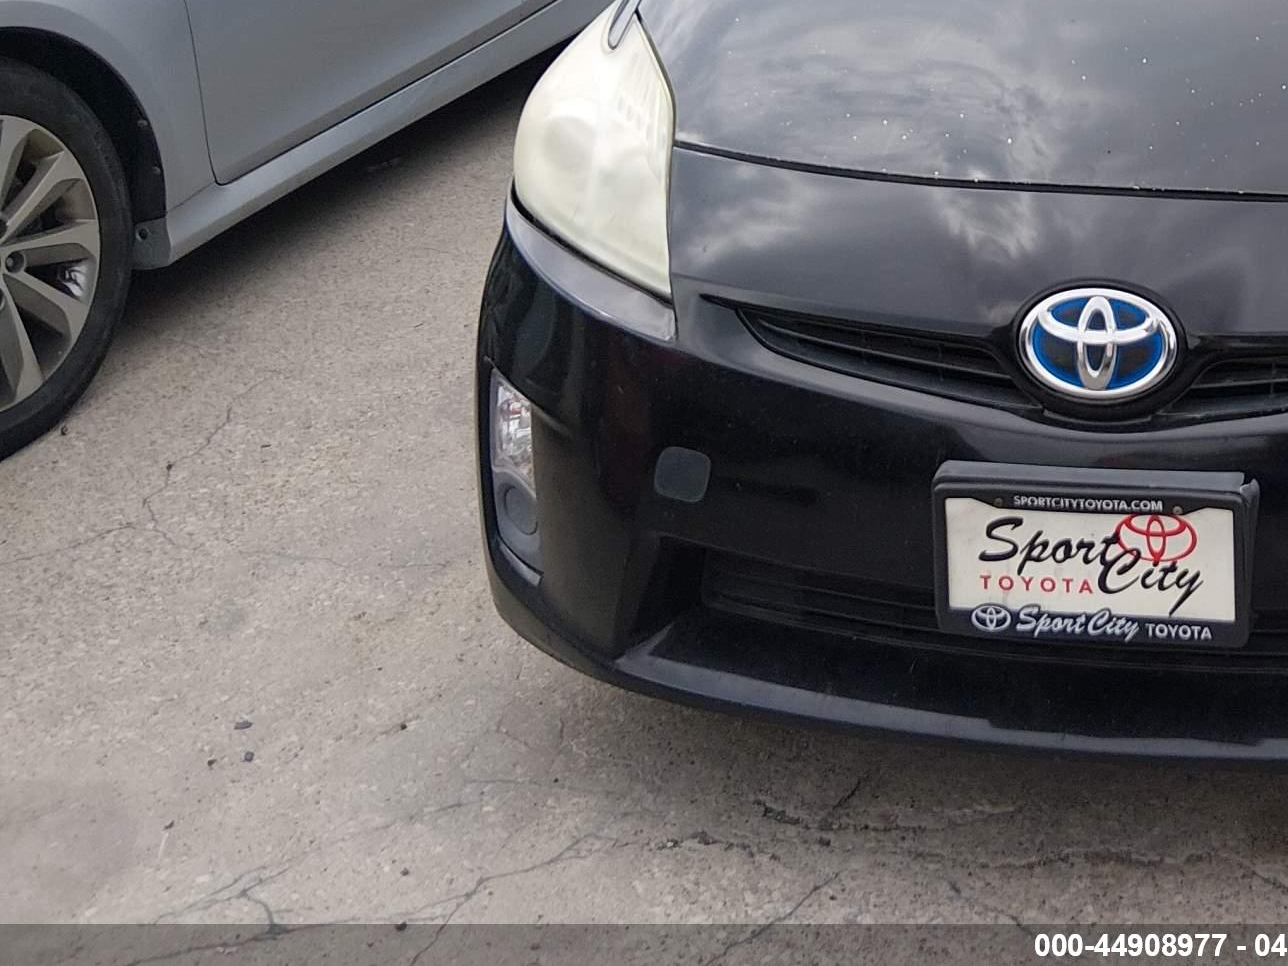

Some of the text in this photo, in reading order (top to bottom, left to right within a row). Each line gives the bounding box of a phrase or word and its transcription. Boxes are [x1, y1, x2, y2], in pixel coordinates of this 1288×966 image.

[1013, 495, 1164, 512] SPORTCITYTOYOTA.COM
[979, 516, 1204, 617] Sport City
[979, 574, 1094, 595] TOYOTA
[1145, 623, 1213, 641] TOYOTA
